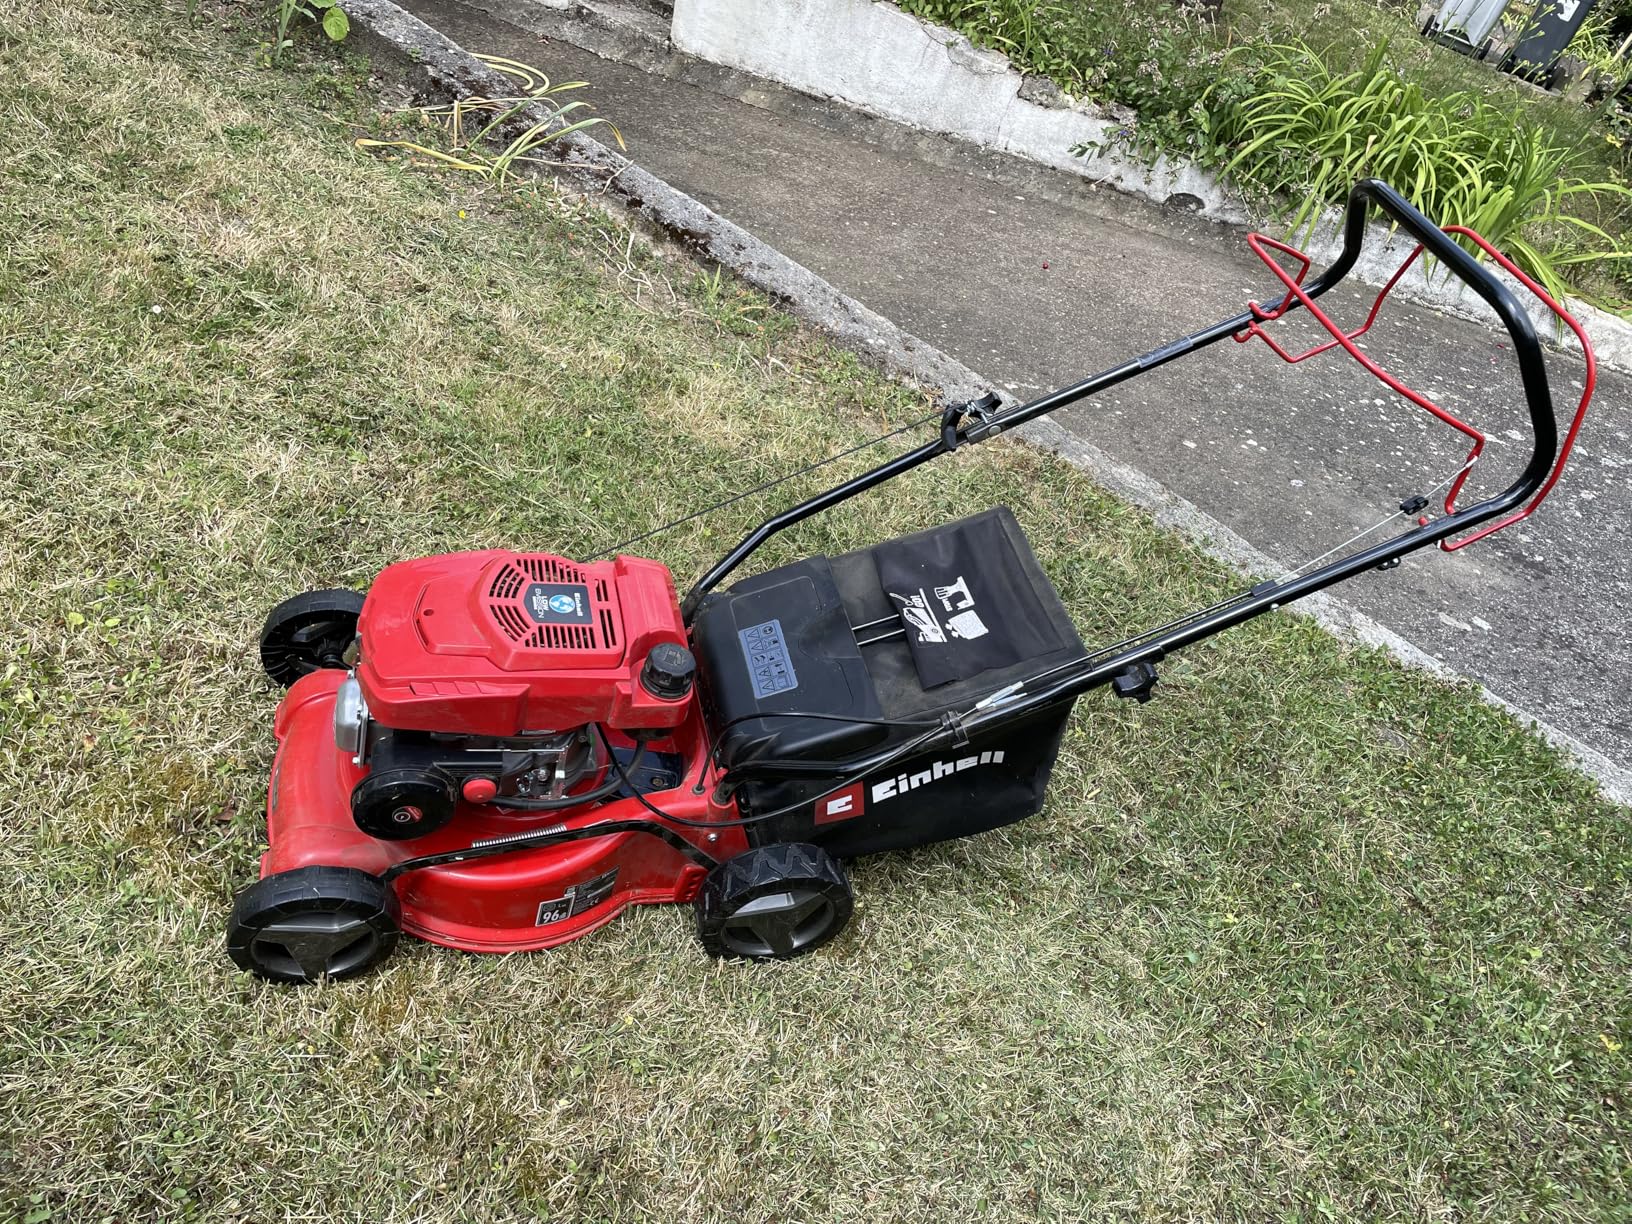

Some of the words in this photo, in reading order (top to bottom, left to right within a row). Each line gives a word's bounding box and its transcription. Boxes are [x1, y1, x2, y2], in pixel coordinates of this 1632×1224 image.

[541, 595, 549, 611] LOW
[574, 593, 583, 617] Einhell
[871, 751, 1005, 804] Einhell
[543, 910, 560, 923] 96
